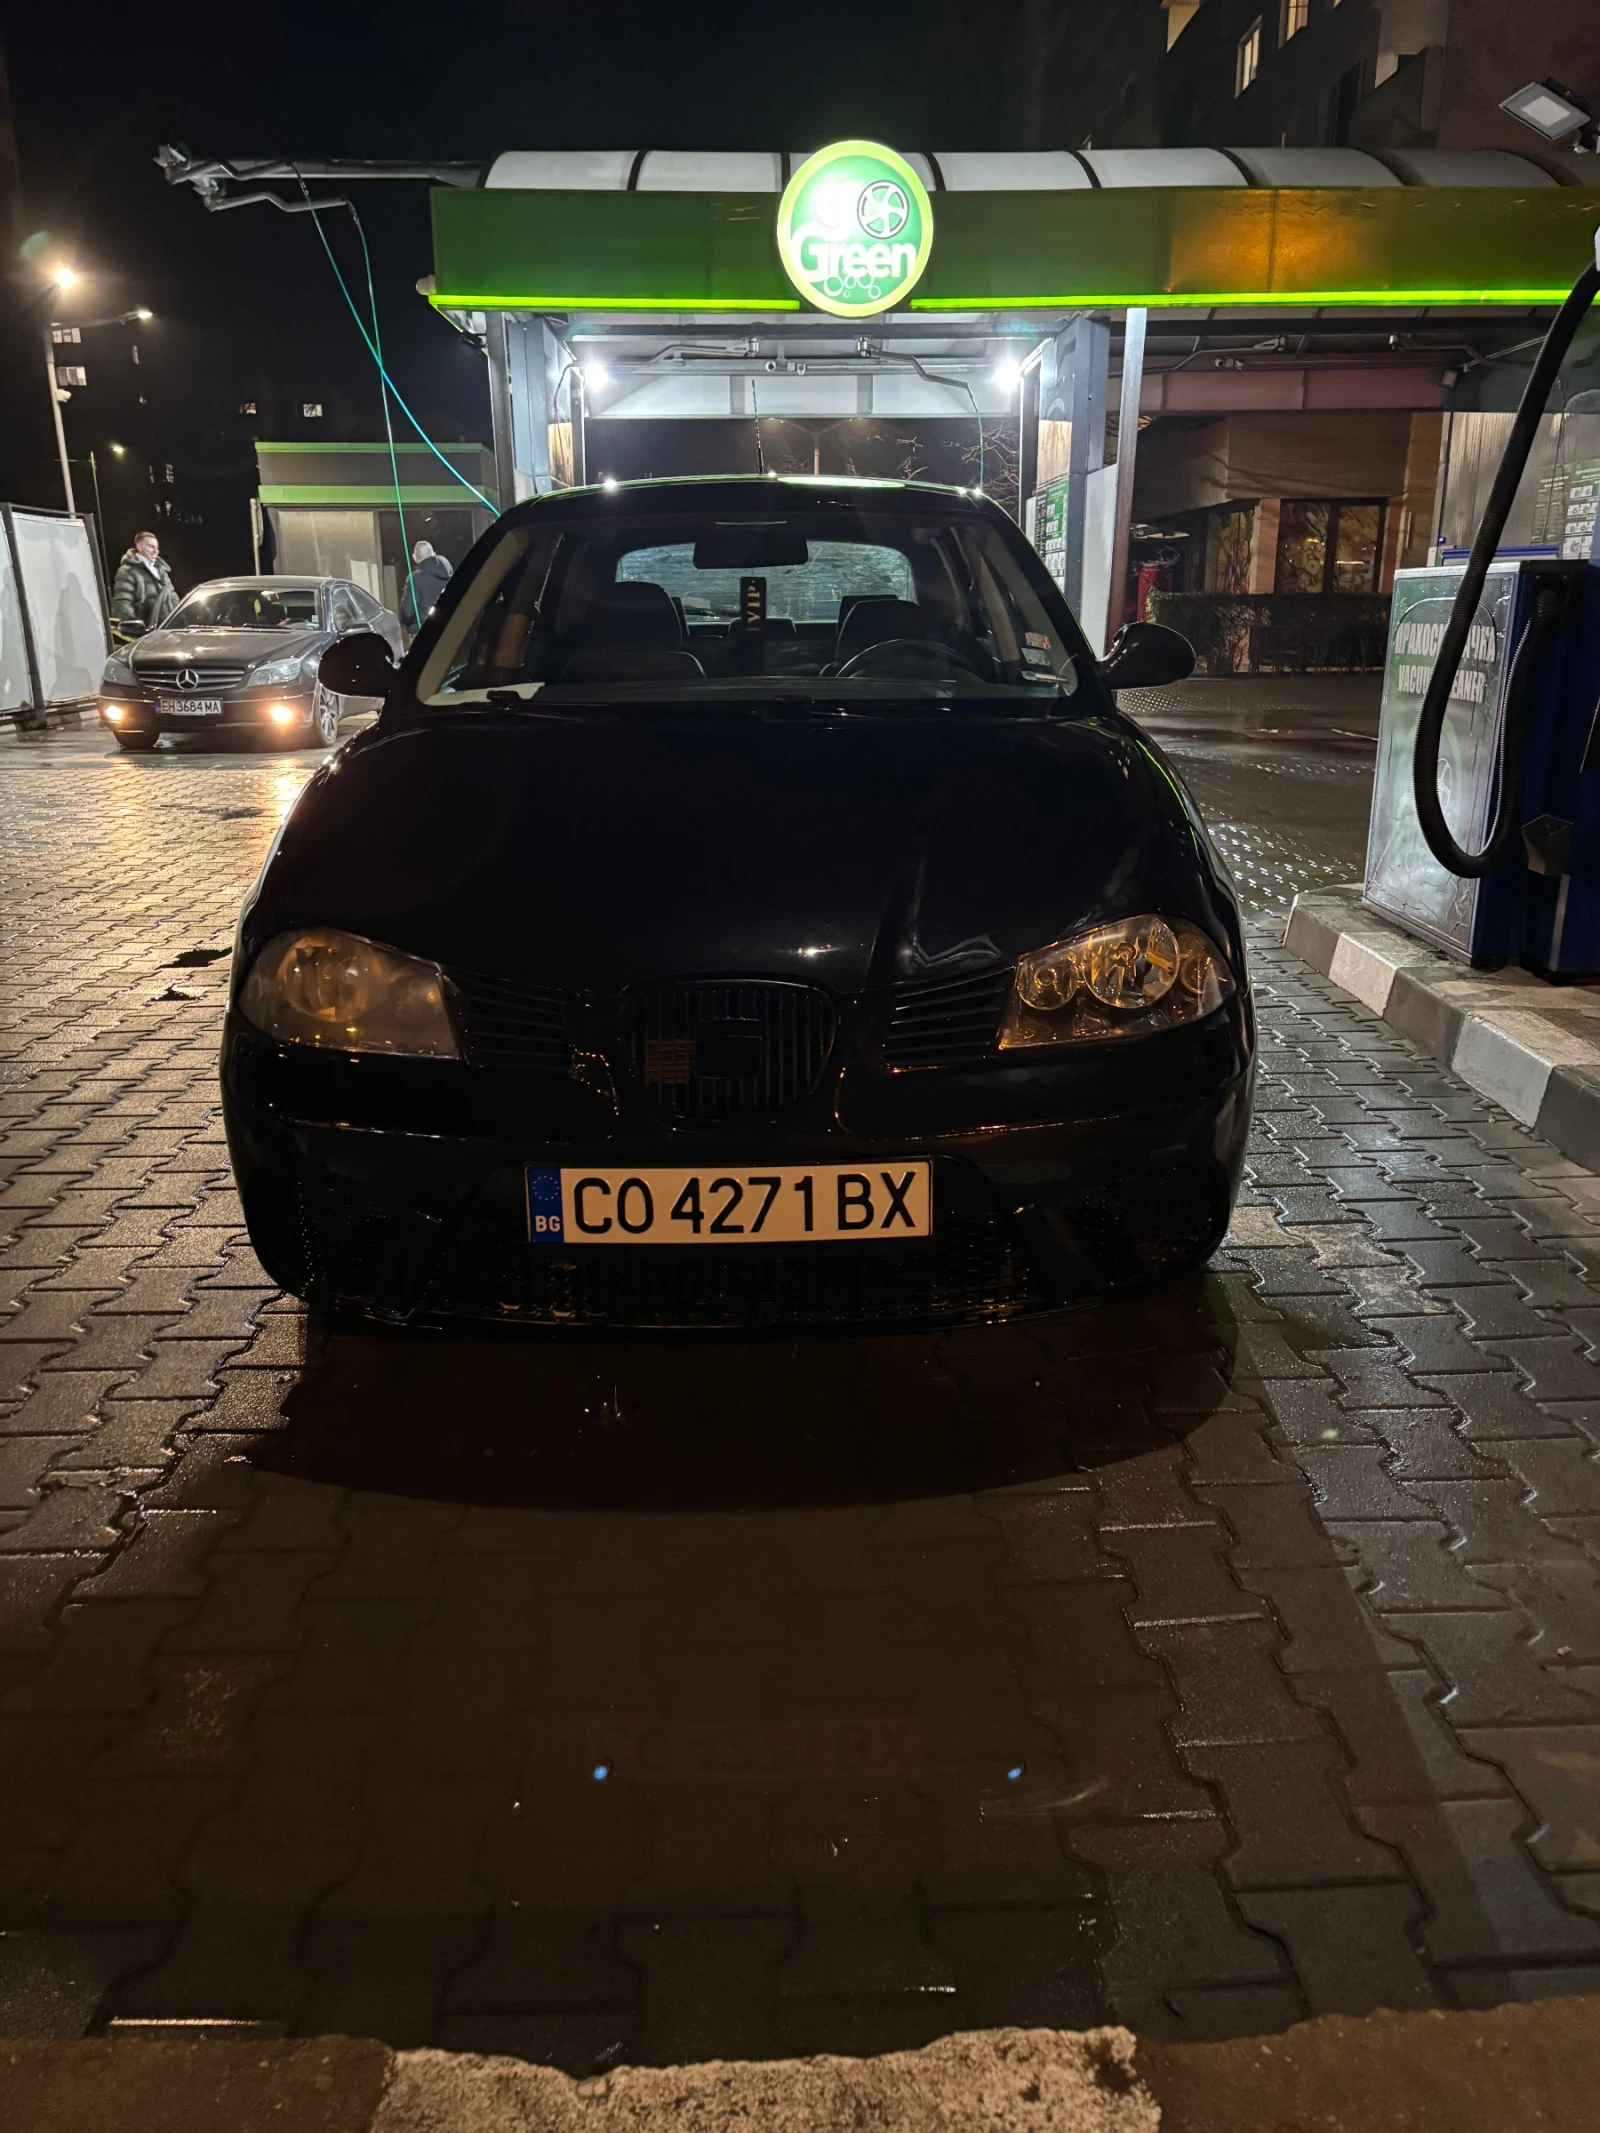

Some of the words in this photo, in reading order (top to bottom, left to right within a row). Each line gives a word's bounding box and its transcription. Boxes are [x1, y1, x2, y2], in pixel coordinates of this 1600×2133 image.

[791, 222, 917, 283] Green
[747, 585, 760, 623] VIP
[1395, 622, 1496, 662] ПРАХОСАЧКА
[176, 700, 204, 712] 3684
[205, 701, 220, 712] MA
[670, 1175, 815, 1234] 4271
[836, 1171, 917, 1231] BX
[535, 1215, 561, 1233] BG
